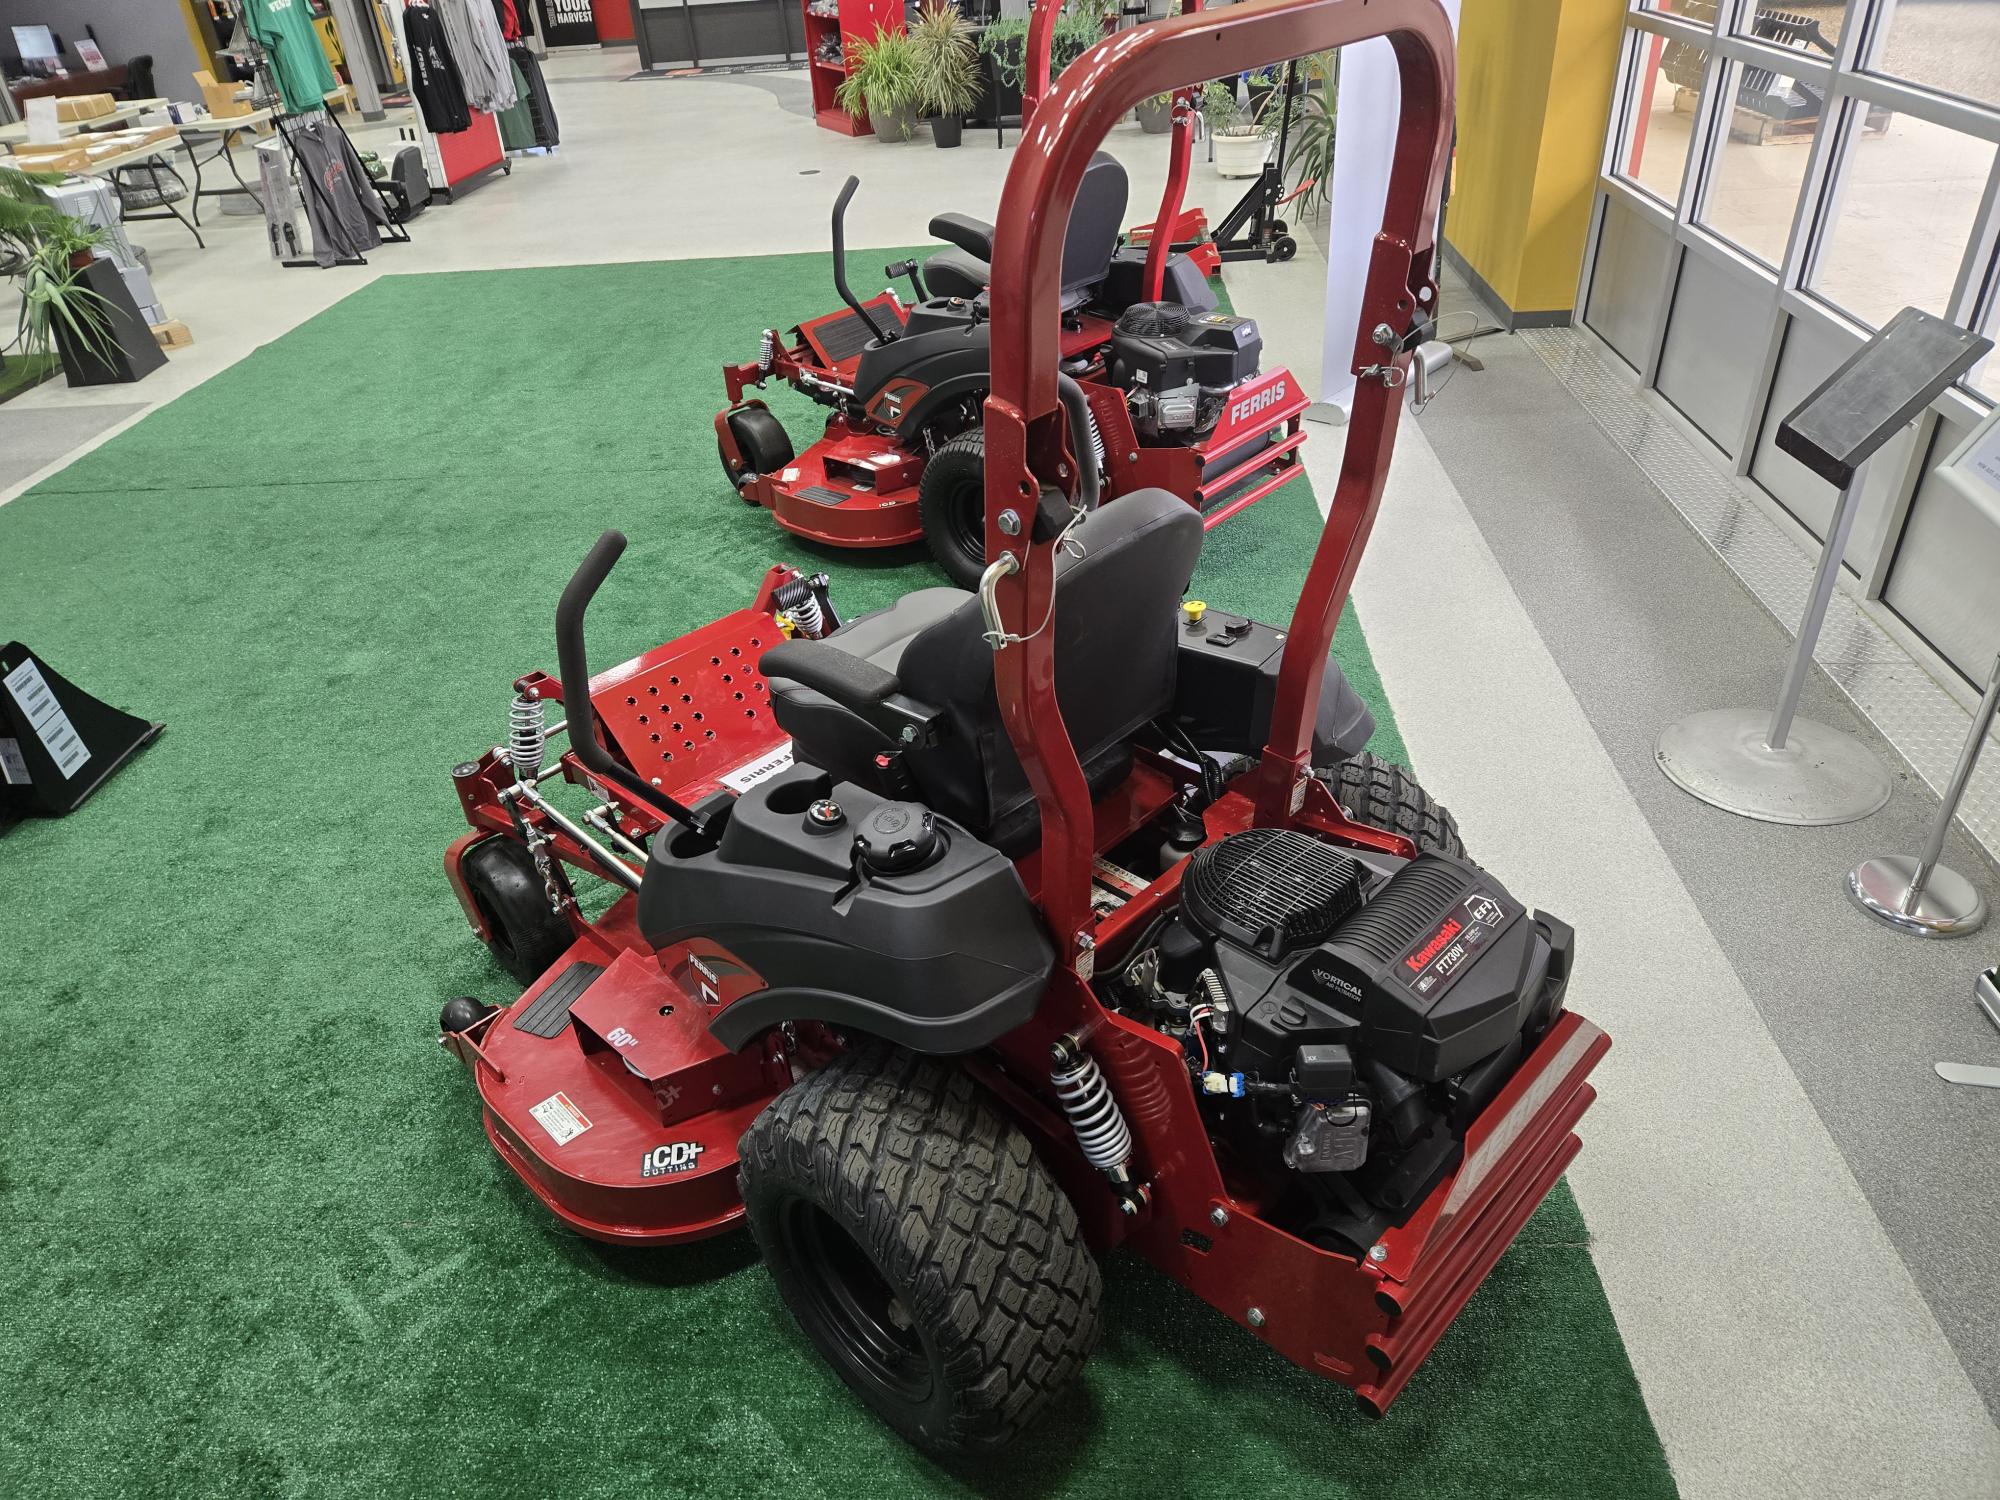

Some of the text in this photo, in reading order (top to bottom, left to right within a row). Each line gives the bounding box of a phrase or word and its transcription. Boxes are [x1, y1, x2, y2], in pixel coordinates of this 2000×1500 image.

[556, 11, 593, 24] HARVEST
[1231, 380, 1286, 426] FERRIS
[740, 754, 792, 784] FERRIS
[1473, 901, 1493, 920] EFI
[1406, 918, 1462, 973] Kawasaki
[1435, 943, 1464, 974] FT730V
[689, 953, 718, 985] FERRIS
[1317, 968, 1362, 997] VORTICAL
[606, 1027, 639, 1047] 60"
[643, 1162, 695, 1177] CUTTING
